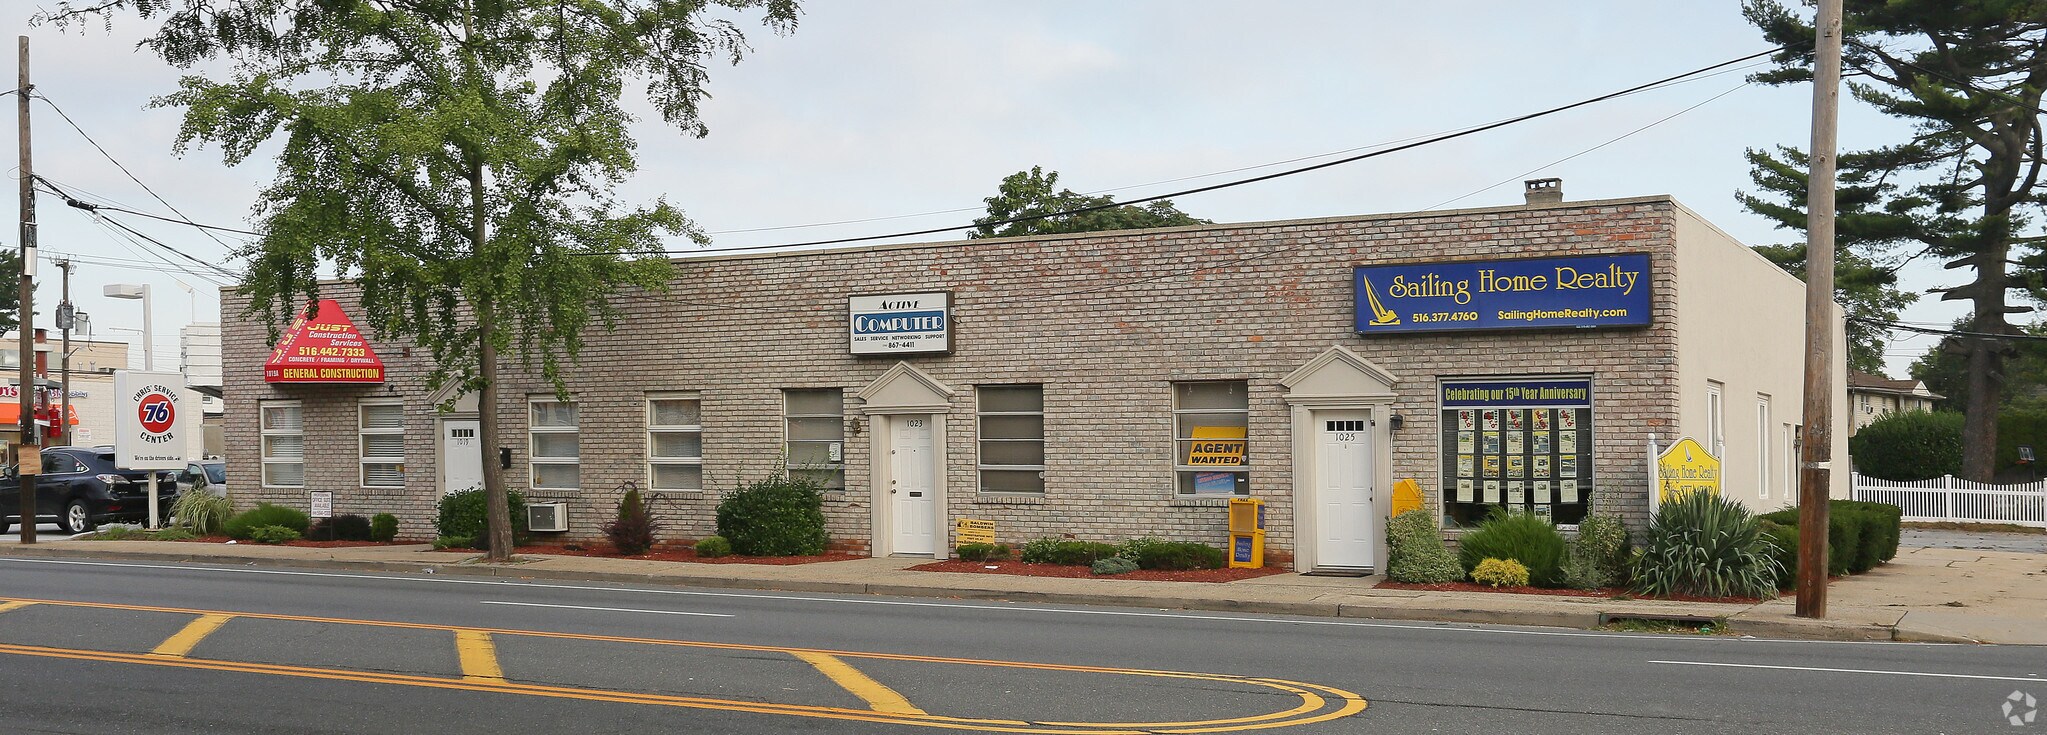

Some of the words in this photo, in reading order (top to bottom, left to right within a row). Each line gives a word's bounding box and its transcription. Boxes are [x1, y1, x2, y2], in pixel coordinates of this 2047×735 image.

[1389, 272, 1471, 305] Sailing
[1478, 269, 1547, 293] Home
[1555, 263, 1639, 296] Realty
[1413, 312, 1478, 323] 516.377.4760
[1498, 308, 1627, 321] SailingHomeRealty.com
[307, 324, 351, 332] JUST
[855, 316, 943, 332] COMPUTER
[309, 331, 356, 339] Construction
[299, 346, 365, 356] 516.442.7333
[283, 368, 318, 378] GENERAL
[320, 369, 379, 379] CONSTRUCTION
[133, 385, 152, 402] CHRIS'
[154, 385, 179, 403] SERVICE
[1446, 388, 1489, 401] Celebrating
[1491, 389, 1504, 400] our
[1505, 387, 1520, 400] 15th
[1521, 387, 1538, 399] Year
[1540, 387, 1586, 401] Anniversary
[143, 401, 169, 423] 76
[907, 419, 923, 427] 1023
[140, 432, 174, 443] CENTER
[1336, 432, 1355, 441] 1025
[1193, 443, 1242, 454] AGENT
[1191, 456, 1239, 464] WANTED
